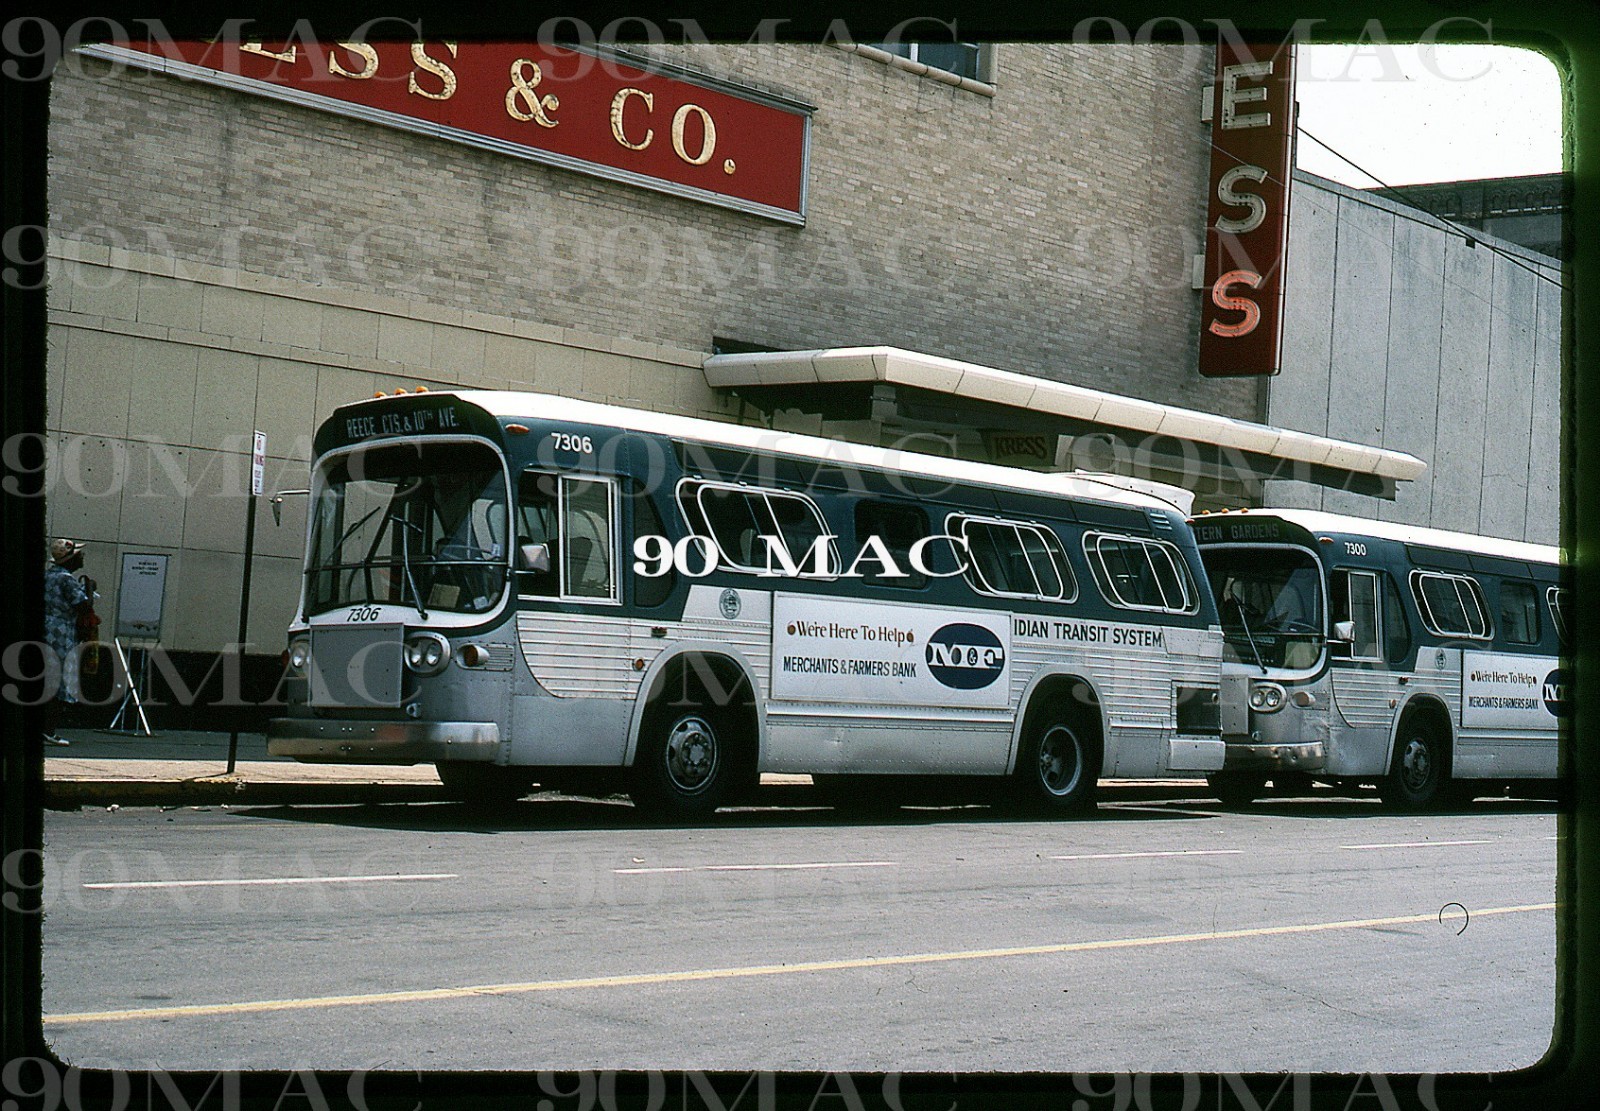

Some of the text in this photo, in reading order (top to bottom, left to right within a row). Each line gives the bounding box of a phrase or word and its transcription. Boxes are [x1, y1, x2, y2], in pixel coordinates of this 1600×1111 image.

[505, 58, 559, 128] &
[609, 87, 736, 175] CO.
[346, 416, 376, 438] REECE
[551, 432, 593, 454] 7306
[1231, 523, 1280, 540] GARDENS
[1344, 542, 1367, 556] 7300
[346, 607, 382, 622] 7306
[829, 623, 858, 640] Here
[861, 625, 876, 641] To
[878, 626, 905, 648] Help
[1014, 619, 1162, 648] IDIAN TRANSIT SYSTEM
[783, 656, 917, 678] MERCHANTS & FARMERS BANK
[1492, 671, 1508, 684] Here
[1509, 672, 1518, 685] To
[1518, 673, 1532, 689] Help
[1468, 695, 1498, 708] MERCHANTS
[1503, 697, 1525, 710] FARMERS
[1525, 698, 1539, 710] BANK
